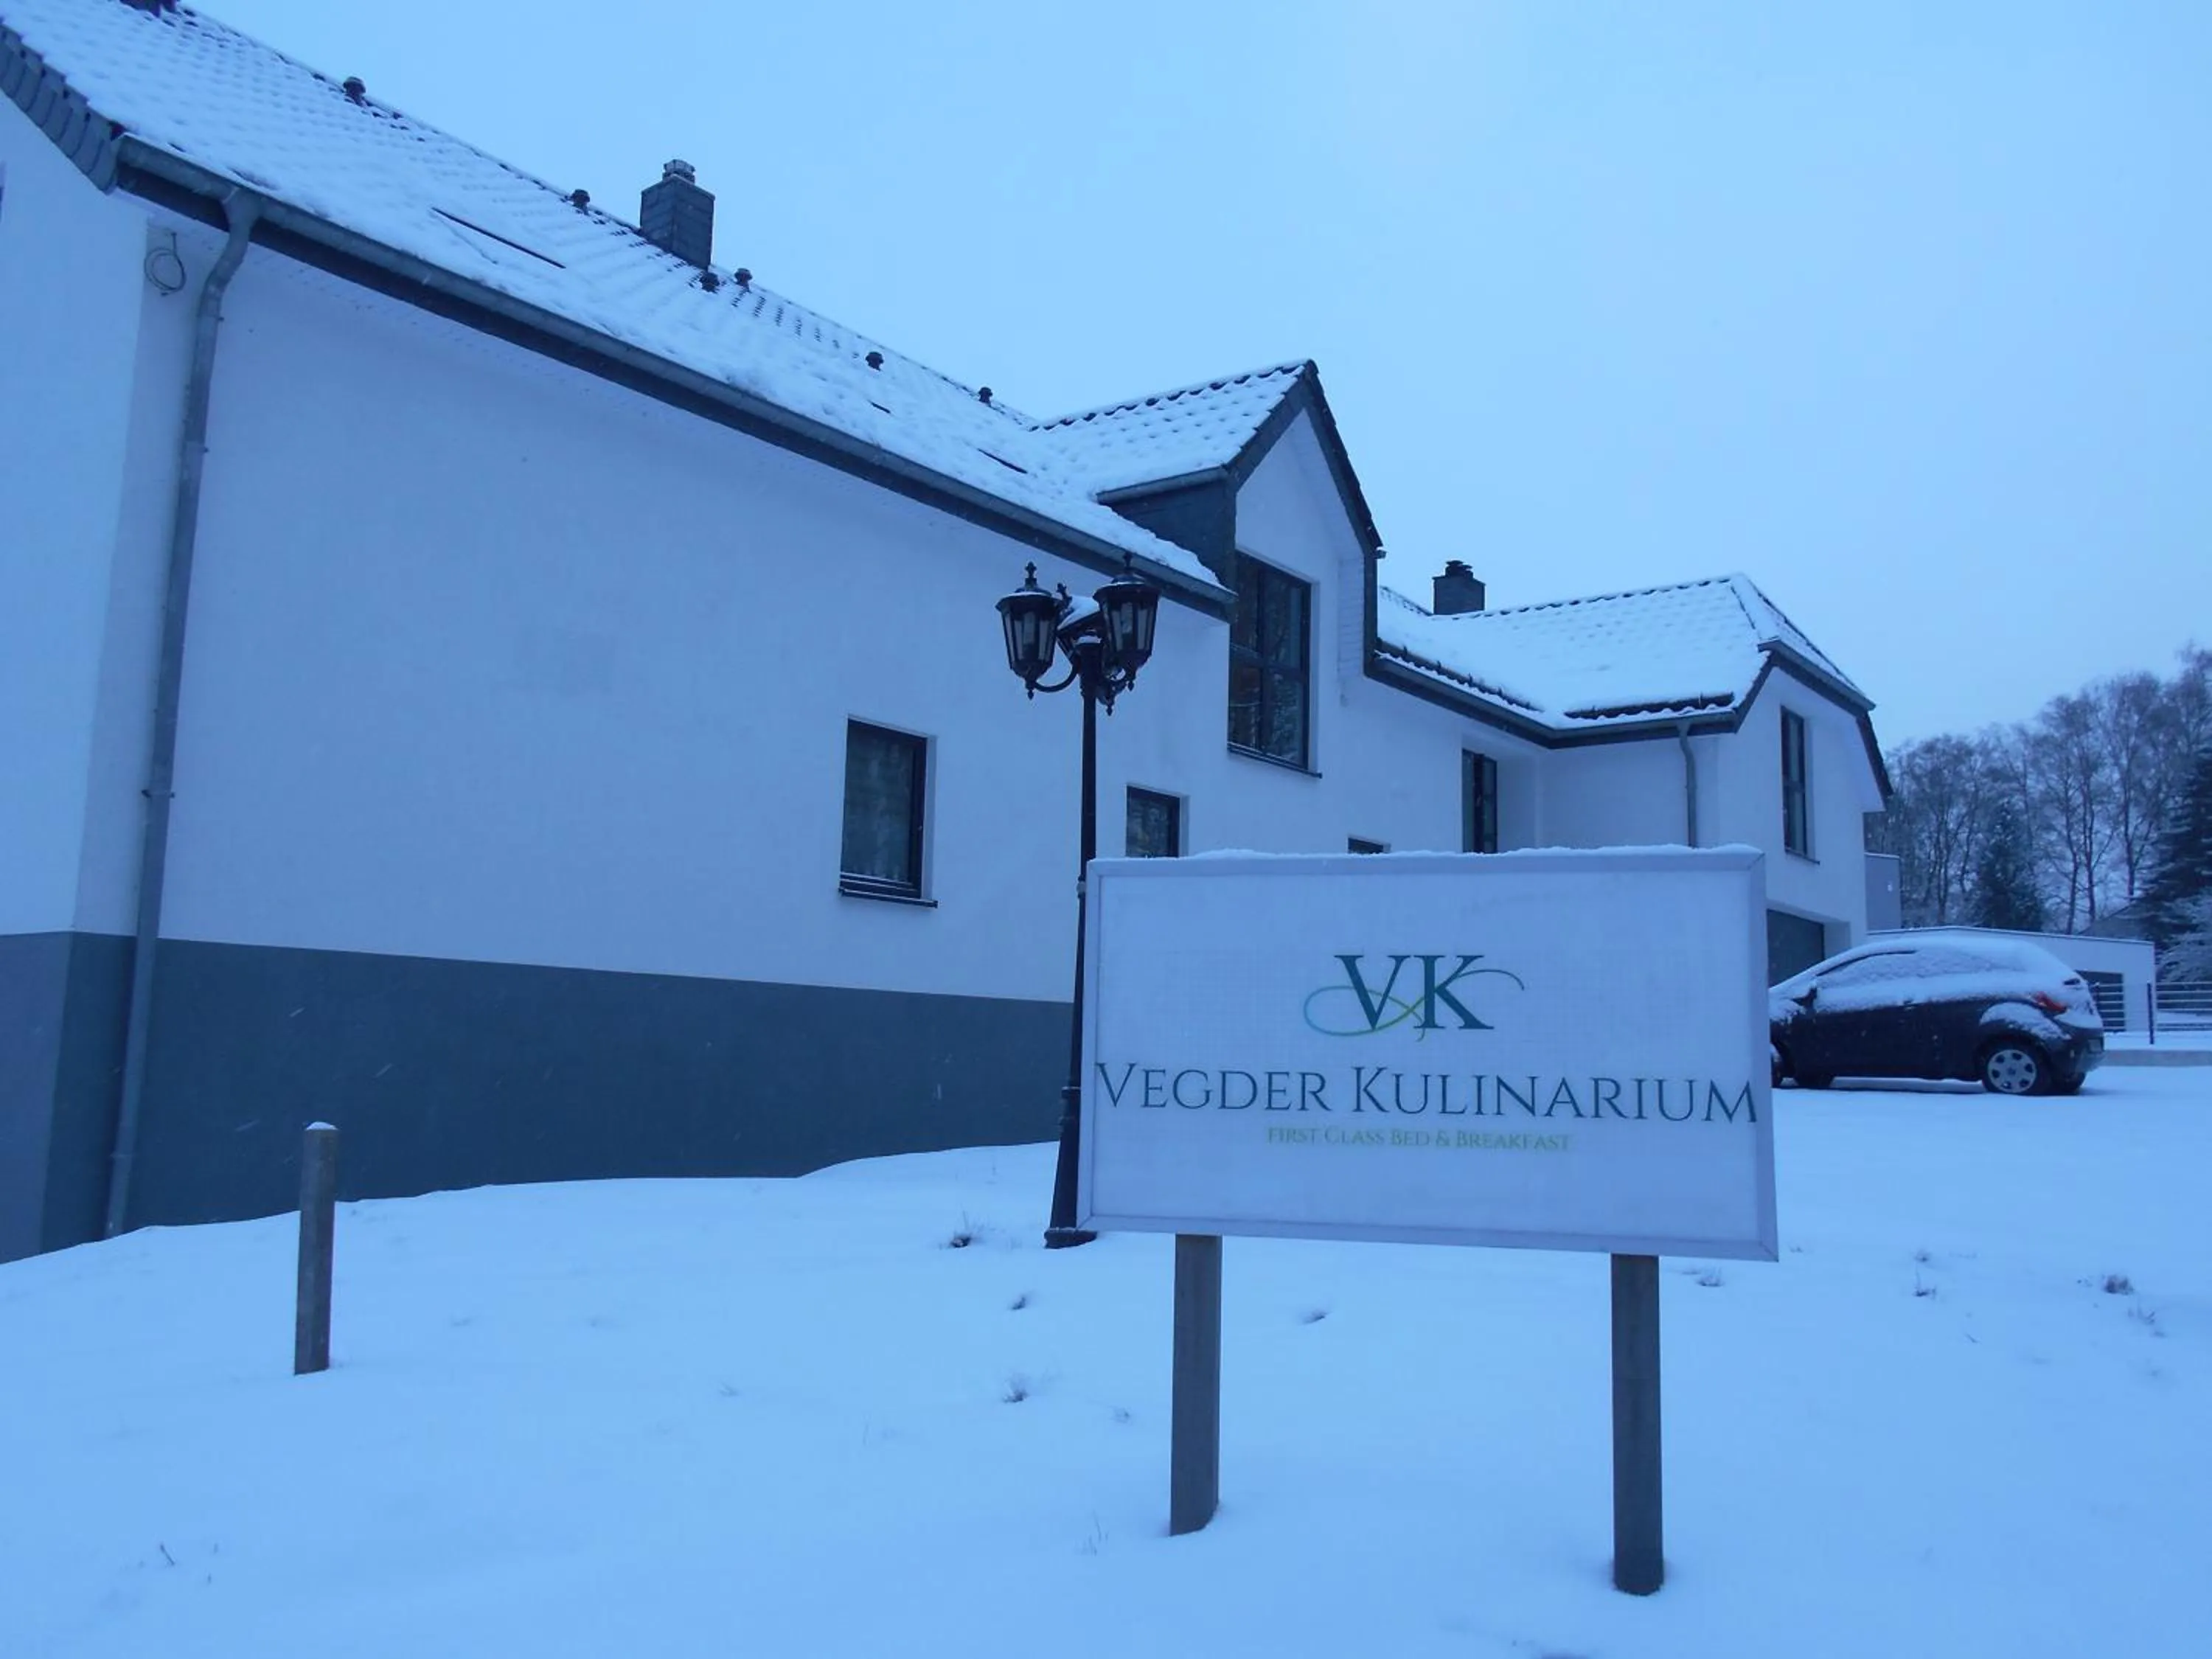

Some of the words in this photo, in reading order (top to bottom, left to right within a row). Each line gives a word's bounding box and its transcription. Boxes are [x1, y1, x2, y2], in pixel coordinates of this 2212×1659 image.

[1332, 953, 1495, 1031] VK
[1094, 1062, 1334, 1112] VEGDER
[1351, 1065, 1759, 1123] KULINARIUM
[1267, 1127, 1318, 1145] FIRST
[1324, 1127, 1385, 1147] CLASS
[1390, 1130, 1430, 1147] BED
[1435, 1130, 1451, 1148] &
[1456, 1130, 1573, 1152] BREAKFAST
